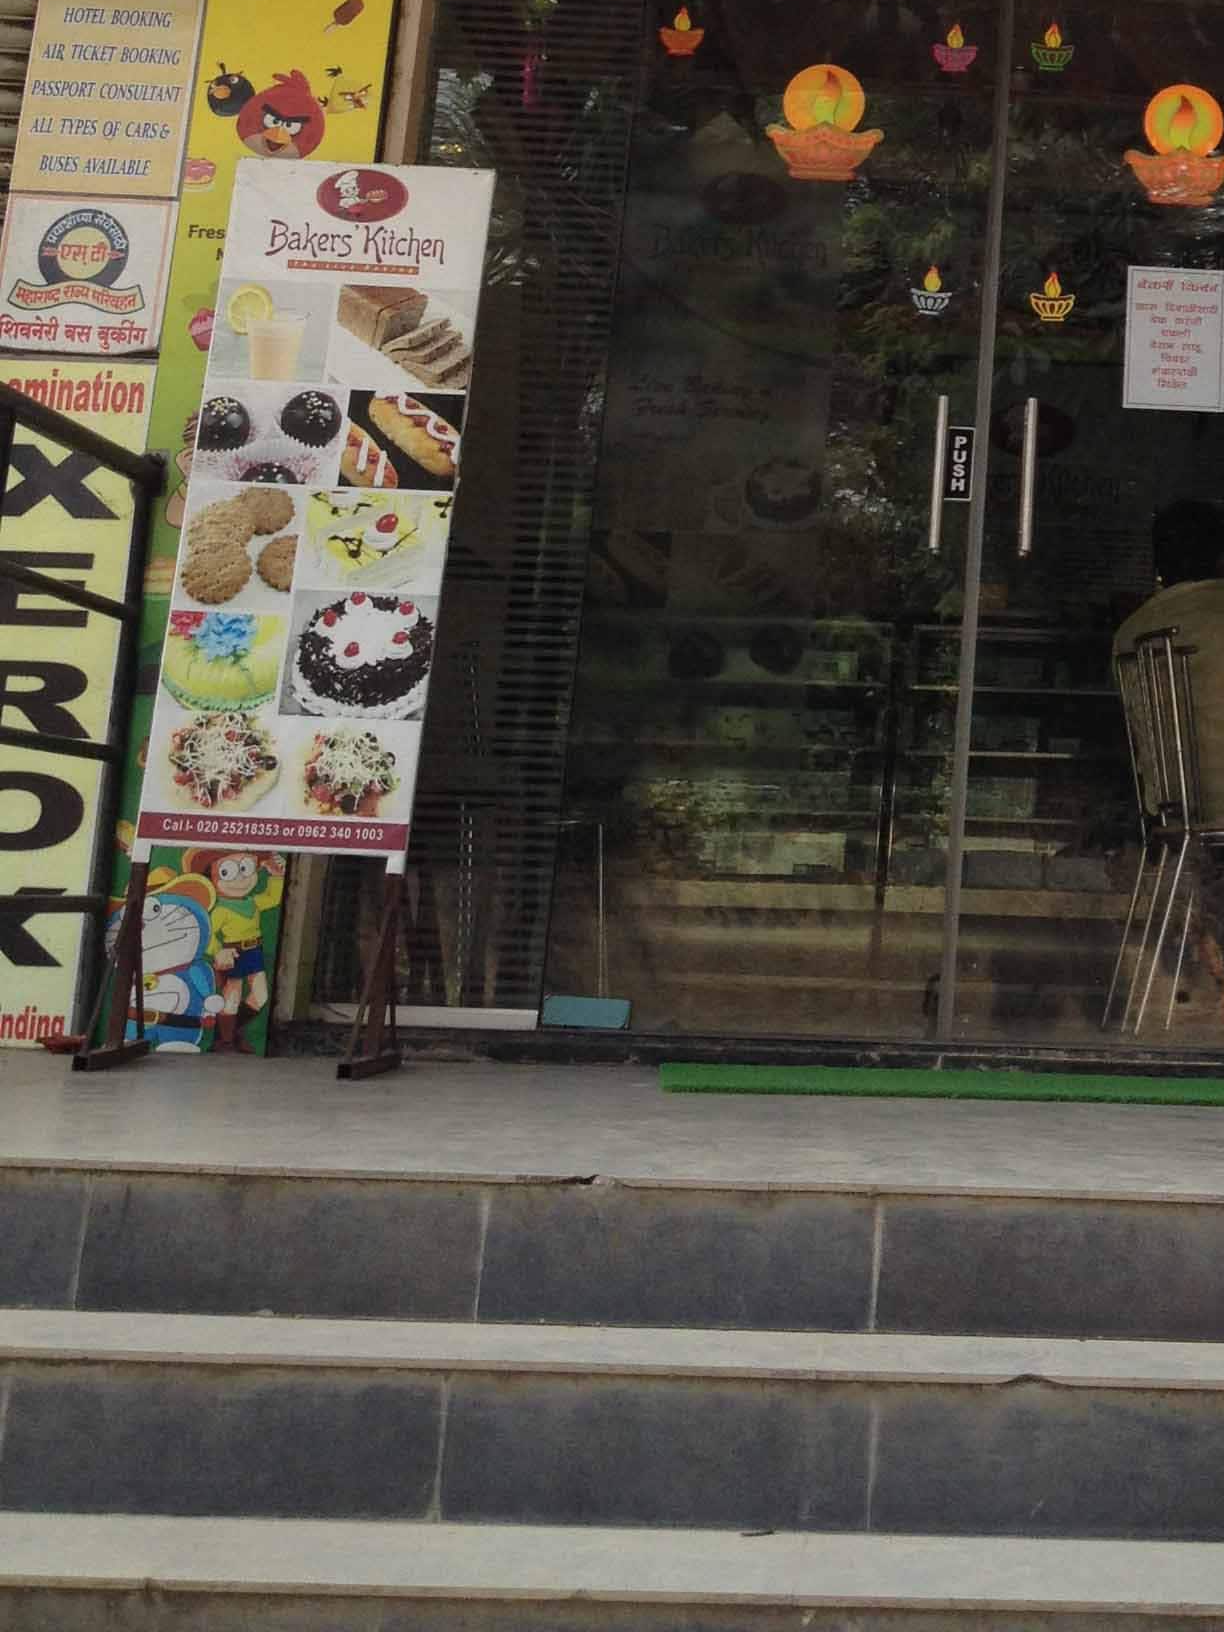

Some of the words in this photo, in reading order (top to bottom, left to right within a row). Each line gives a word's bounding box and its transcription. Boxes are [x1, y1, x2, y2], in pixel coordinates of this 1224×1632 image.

[63, 7, 105, 25] HOTEL
[111, 9, 173, 28] BOOKING
[41, 43, 66, 61] AIR
[71, 43, 117, 63] TICKET
[120, 46, 182, 66] BOOKING
[31, 79, 97, 99] PASSPORT
[100, 82, 184, 103] CONSULTANT
[30, 117, 54, 134] ALL
[60, 118, 99, 136] TYPES
[102, 120, 122, 138] OF
[39, 154, 80, 173] BUSES
[83, 157, 151, 176] AVAILABLE
[264, 219, 359, 257] Bakers'
[363, 225, 445, 264] Kitchen
[951, 434, 968, 492] PUSH
[197, 820, 218, 834] 020
[221, 821, 280, 836] 25218353
[282, 827, 295, 837] or
[297, 824, 326, 838] 0962
[329, 826, 351, 840] 340
[355, 828, 384, 841] 1003
